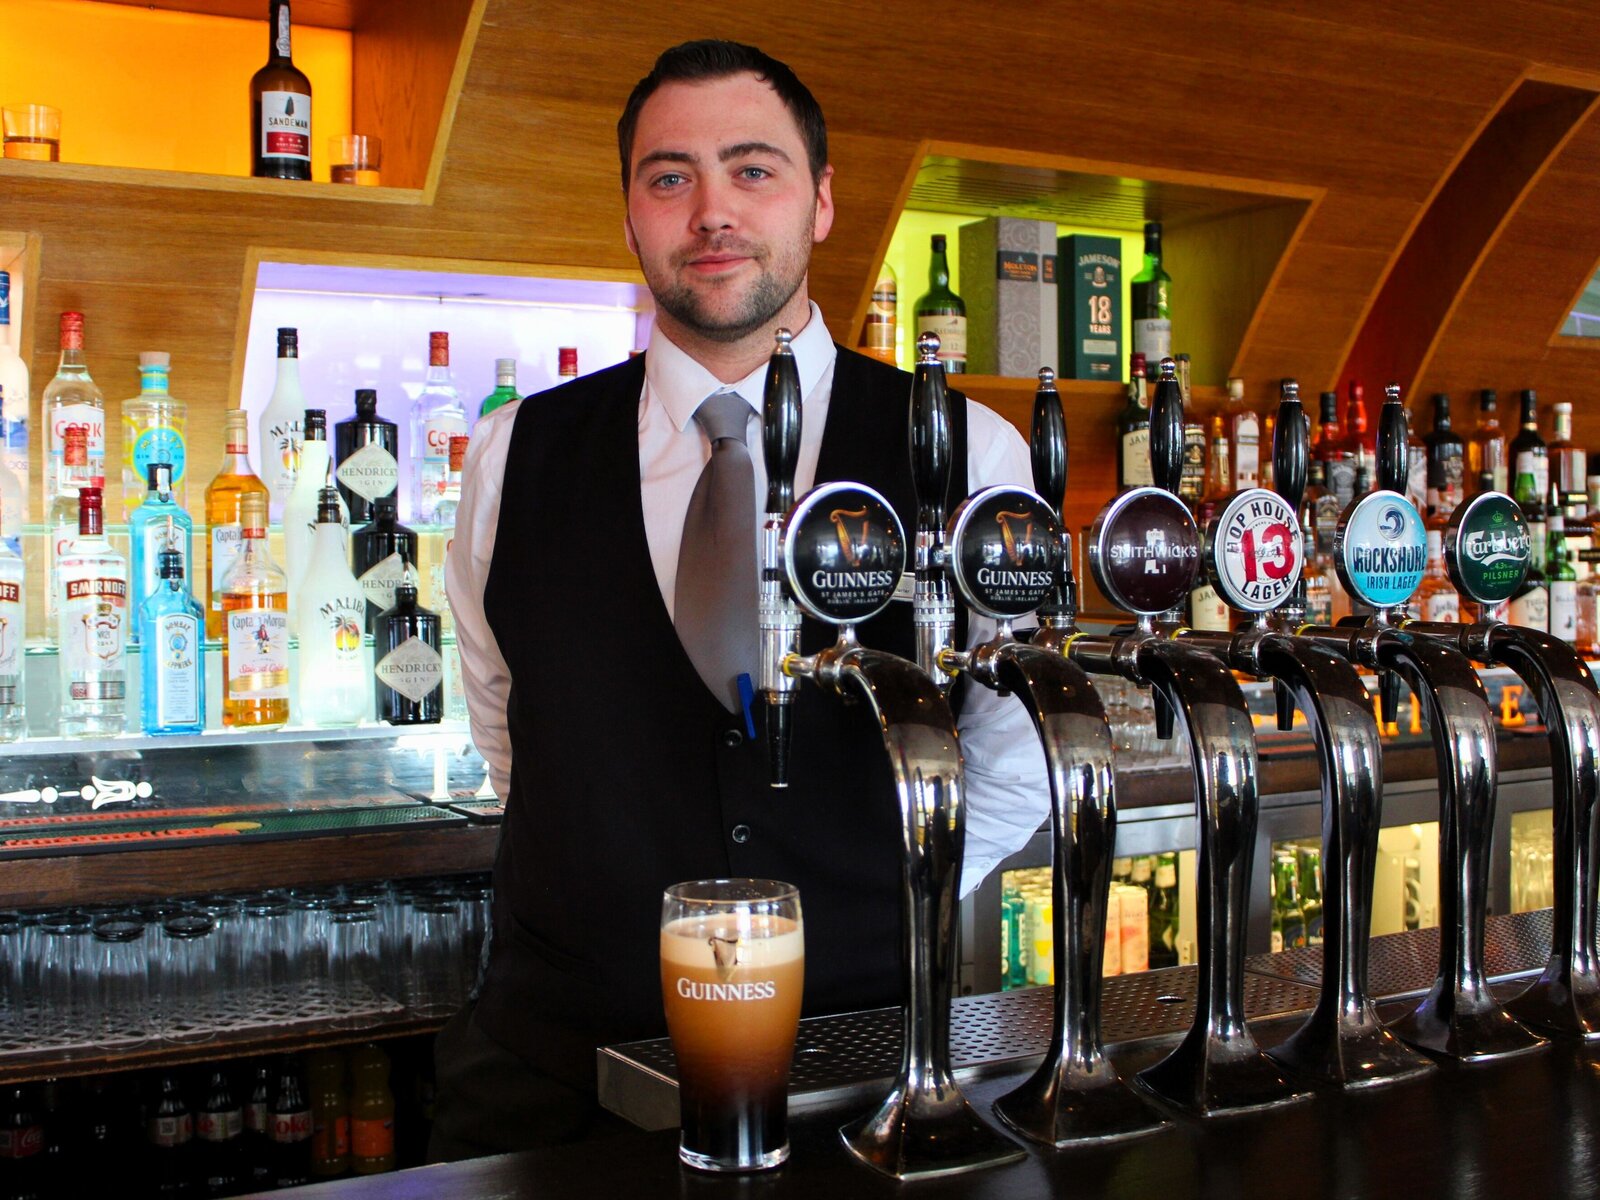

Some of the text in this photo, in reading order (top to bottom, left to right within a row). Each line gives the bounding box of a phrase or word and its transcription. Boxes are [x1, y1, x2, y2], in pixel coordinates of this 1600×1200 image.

[268, 117, 309, 129] SANDEMAN
[1078, 253, 1121, 269] JAMESON
[1088, 295, 1113, 325] 18
[1089, 323, 1112, 334] YEARS
[1226, 513, 1247, 554] HOP
[1250, 501, 1299, 540] HOUSE
[1110, 544, 1198, 558] SMITHWICK'S
[1241, 523, 1295, 582] 13
[1465, 530, 1532, 561] Carlsberg
[1353, 543, 1427, 573] ROCKSHORE
[812, 569, 894, 588] GUINNESS
[977, 567, 1053, 586] GUINNESS
[1366, 575, 1417, 590] IRISH LAGER
[1482, 569, 1520, 580] PILSNER
[70, 580, 127, 596] SMIRNOFF
[867, 589, 885, 598] GATE
[1242, 574, 1292, 600] LAGER
[676, 977, 776, 1001] GUINNESS
